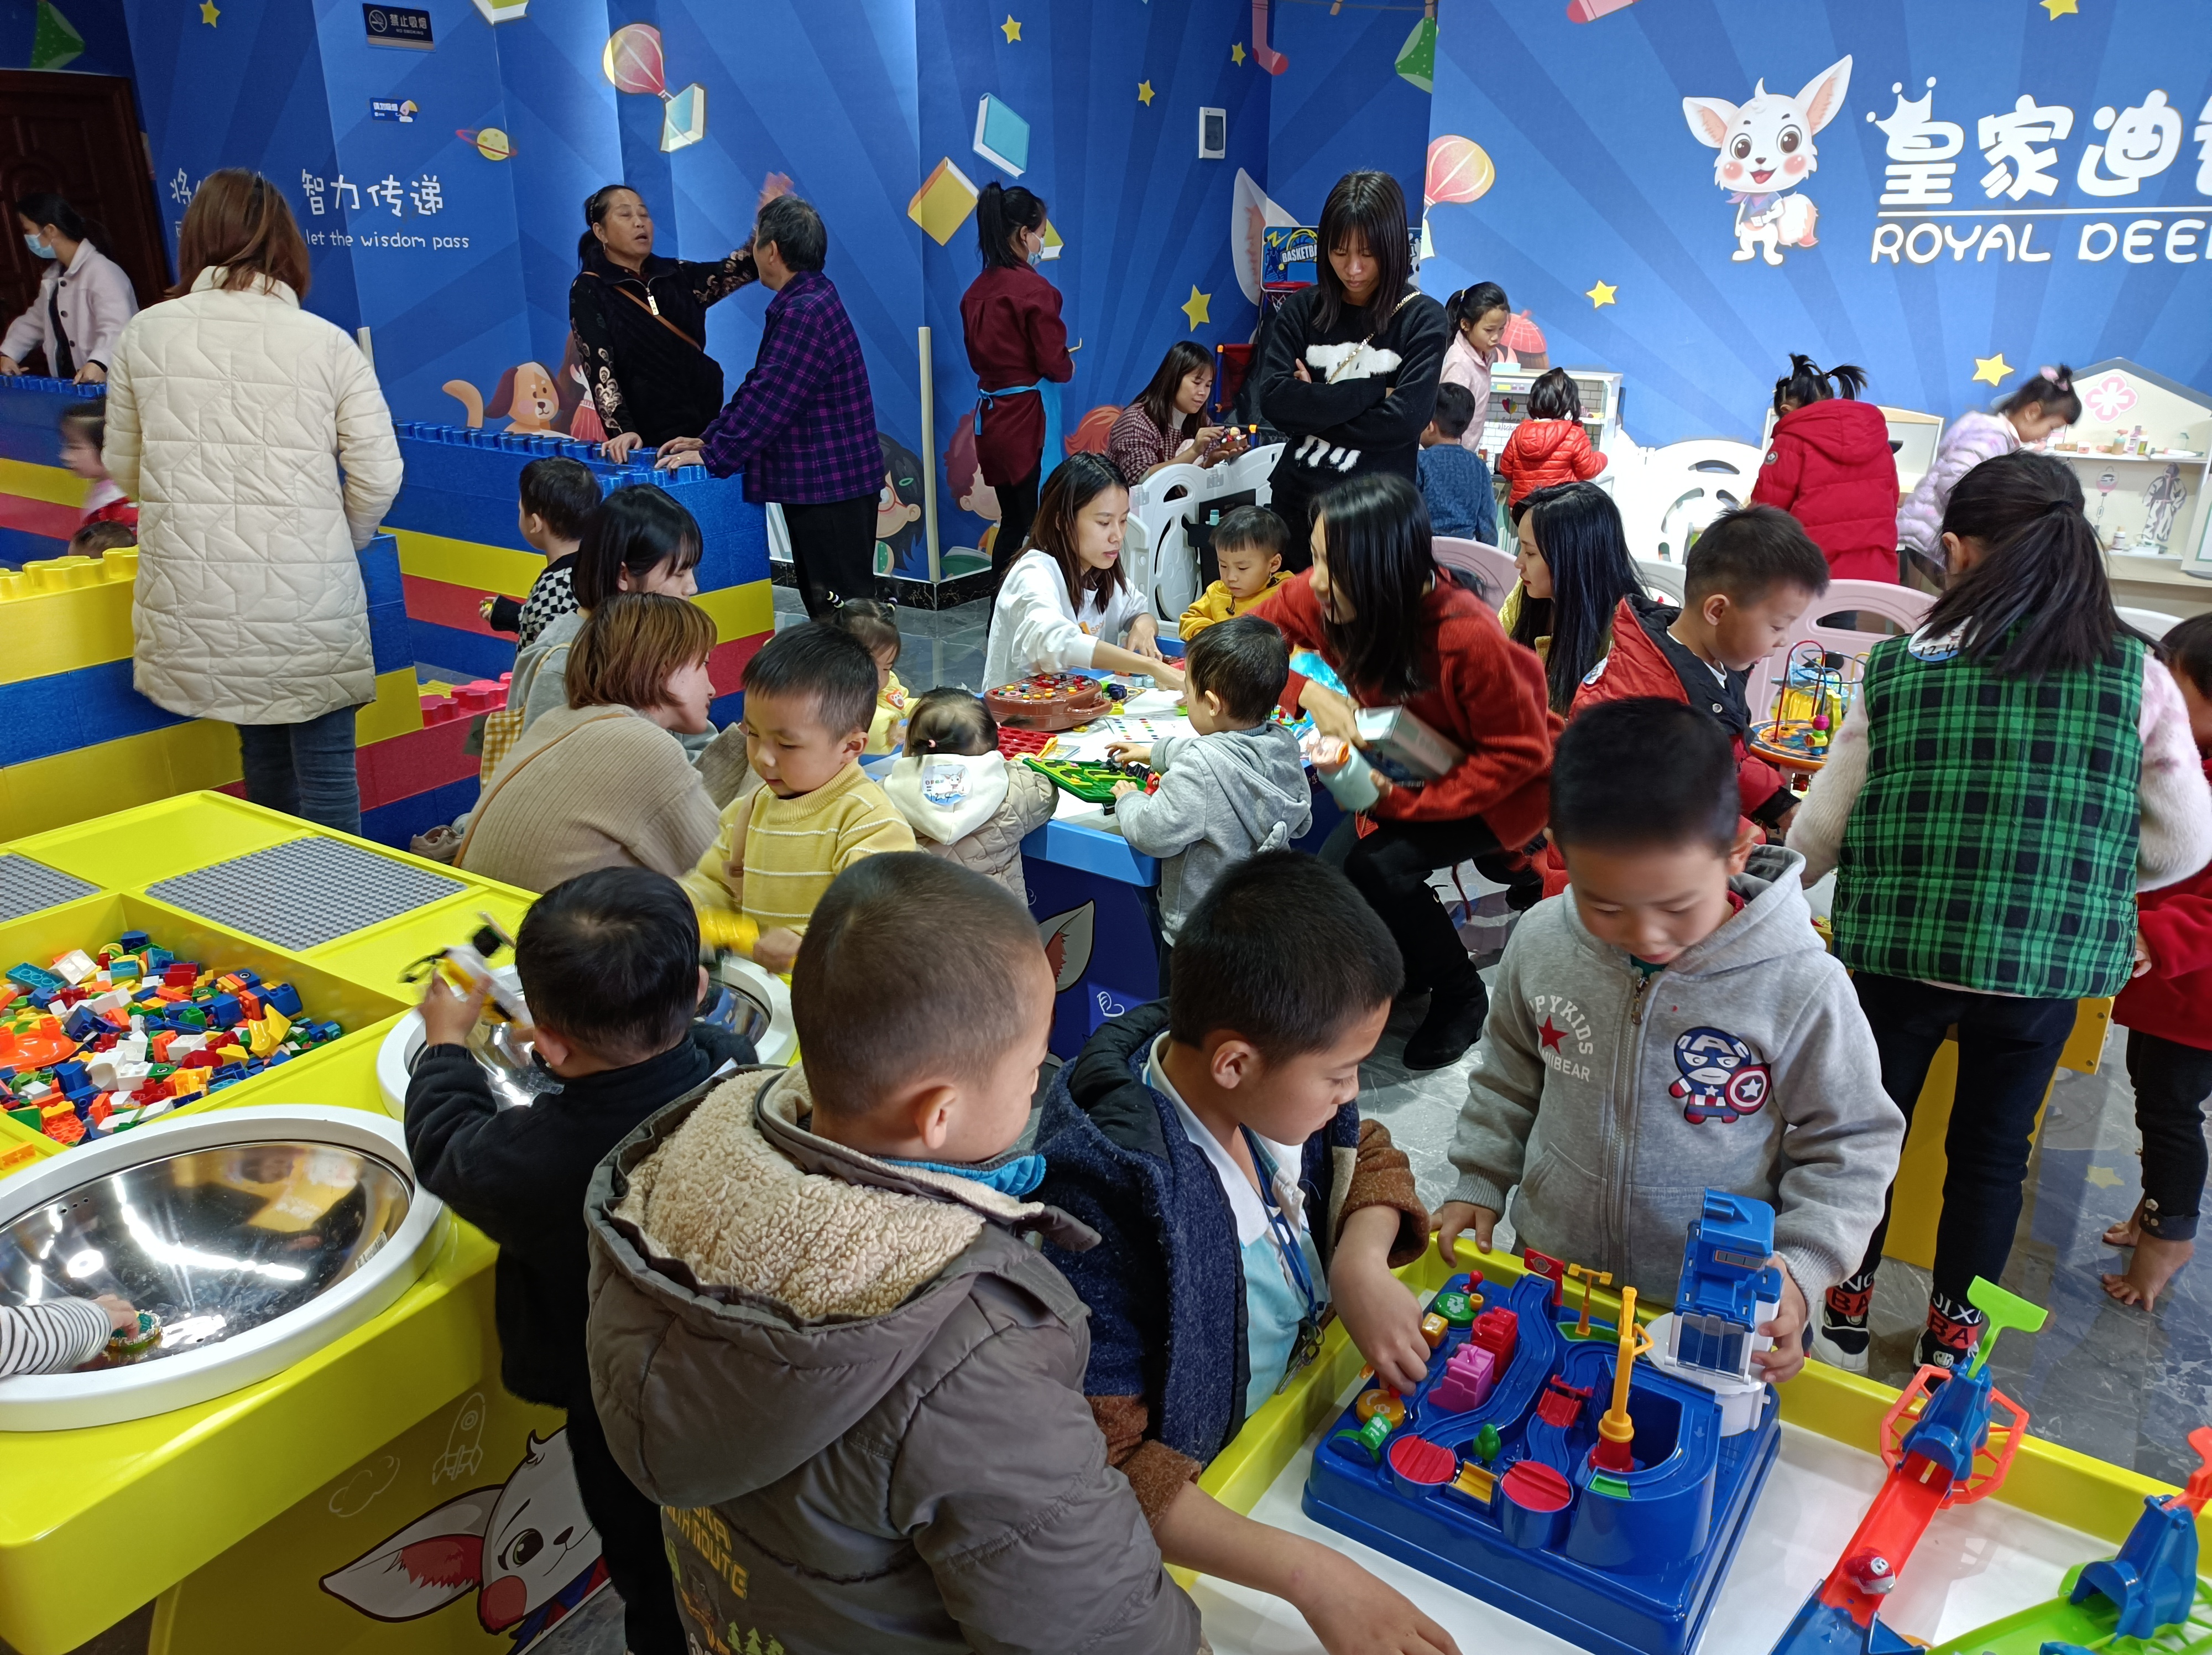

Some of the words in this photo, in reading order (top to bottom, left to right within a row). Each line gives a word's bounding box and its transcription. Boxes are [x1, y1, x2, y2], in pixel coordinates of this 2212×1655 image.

[1866, 76, 2212, 204] 皇家迪
[302, 169, 443, 216] 智力传递
[306, 230, 325, 246] let
[330, 231, 353, 247] the
[361, 231, 426, 248] wisdom
[432, 235, 469, 250] pass
[1871, 222, 2051, 264] ROYAL
